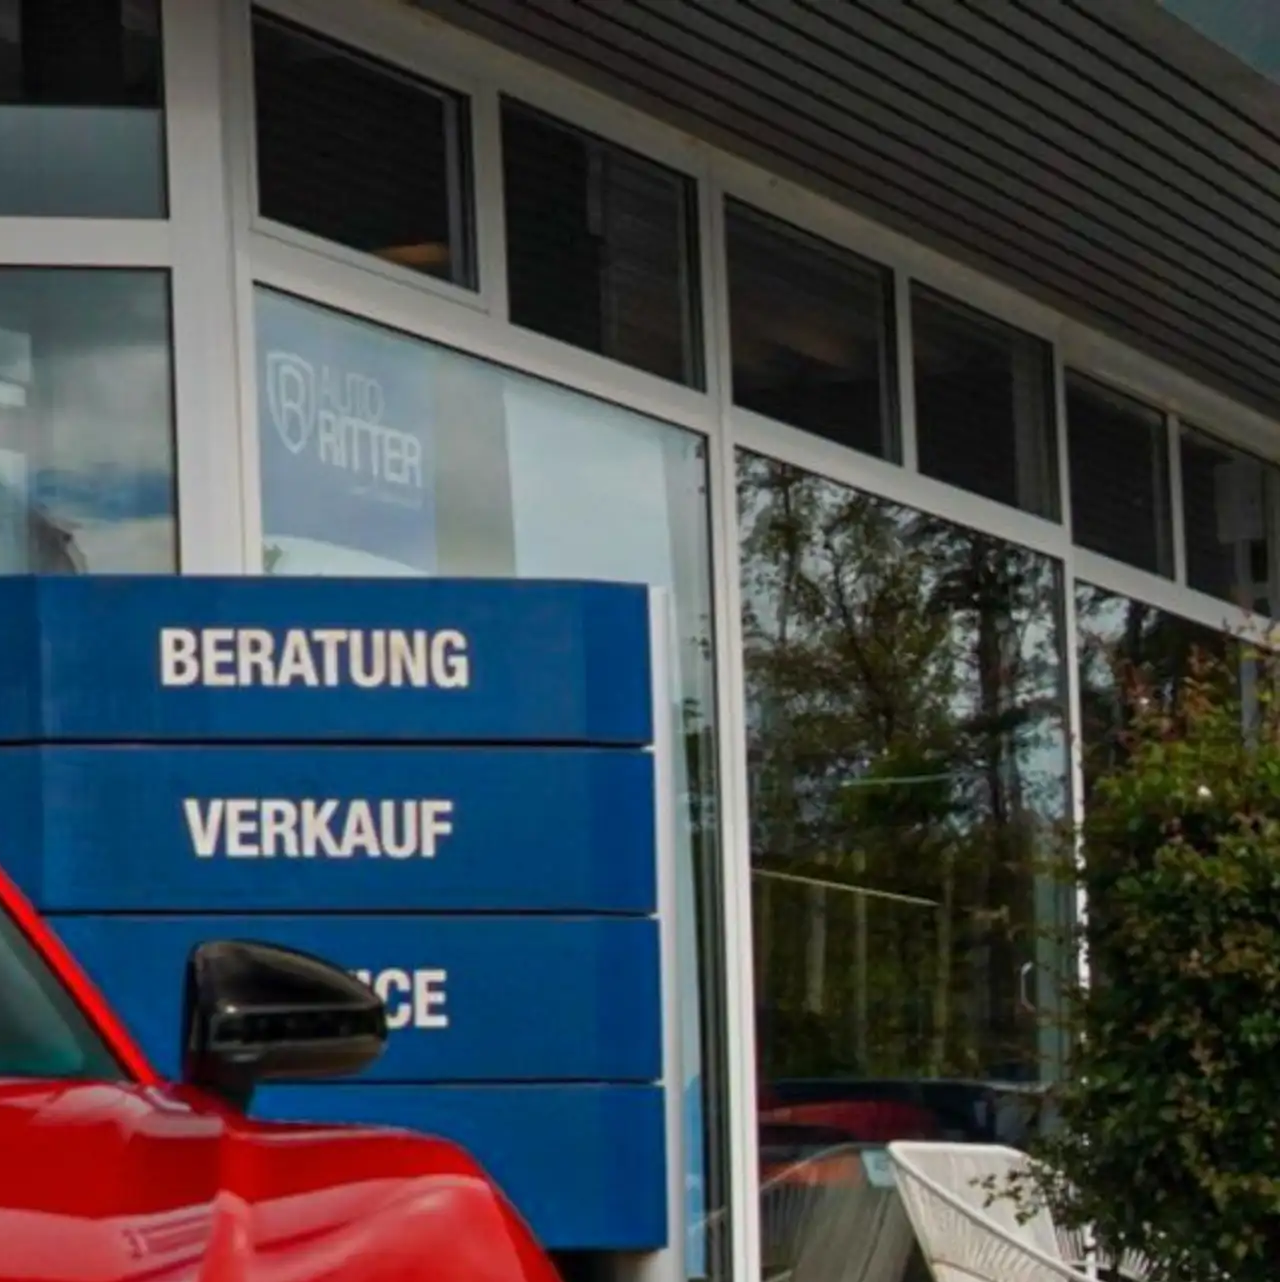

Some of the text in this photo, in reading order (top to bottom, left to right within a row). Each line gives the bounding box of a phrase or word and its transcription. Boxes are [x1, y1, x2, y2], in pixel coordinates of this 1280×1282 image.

[318, 409, 422, 488] RITTER
[159, 628, 470, 688] BERATUNG
[183, 798, 454, 858] VERKAUF
